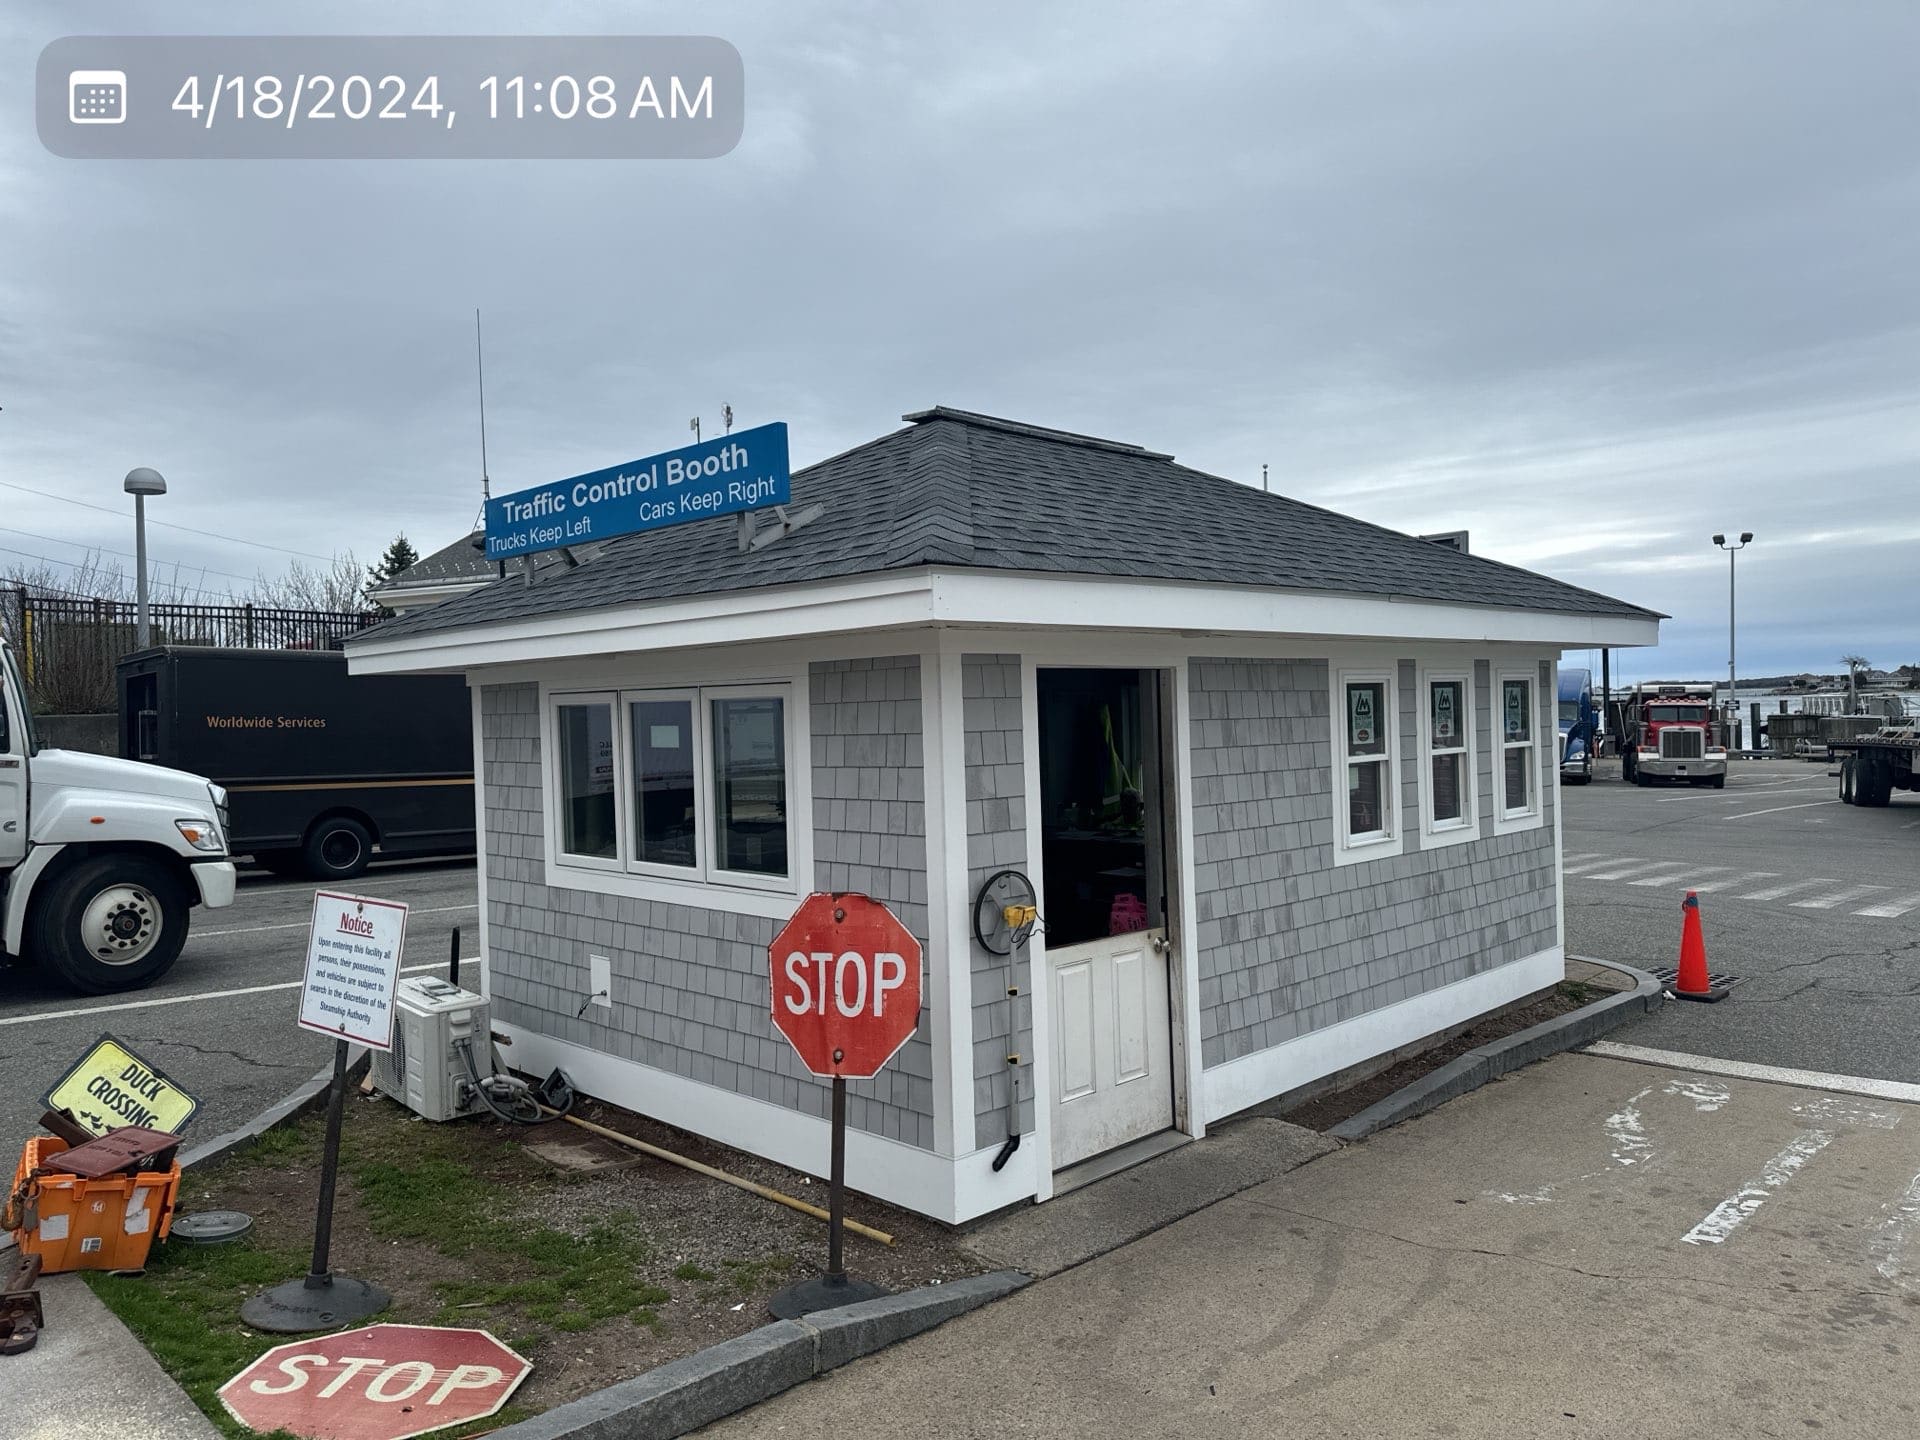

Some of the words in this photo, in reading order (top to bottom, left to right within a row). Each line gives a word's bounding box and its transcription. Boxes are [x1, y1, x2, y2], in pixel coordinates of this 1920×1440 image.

[503, 491, 566, 524] Traffic
[572, 463, 658, 508] Control
[666, 442, 749, 487] Booth
[639, 500, 676, 522] Cars
[680, 489, 722, 514] Keep
[728, 475, 775, 504] Right
[489, 529, 527, 553] Trucks
[529, 523, 563, 546] Keep
[566, 515, 592, 537] Left
[206, 716, 274, 729] Worldwide
[277, 716, 326, 728] Services
[340, 912, 374, 935] Notice
[318, 937, 332, 948] Upon
[332, 941, 353, 954] entering
[354, 943, 364, 954] this
[365, 946, 383, 960] facility
[383, 950, 392, 959] all
[316, 969, 326, 978] and
[327, 971, 347, 983] vehicles
[347, 977, 357, 986] are
[357, 978, 377, 991] subject
[378, 983, 385, 992] to
[318, 954, 339, 966] persons,
[340, 957, 351, 968] their
[352, 962, 386, 976] possessions,
[310, 984, 327, 994] search
[328, 986, 333, 995] in
[334, 988, 343, 999] the
[343, 991, 370, 1005] discretion
[370, 998, 377, 1007] of
[377, 999, 387, 1010] the
[784, 951, 907, 1018] STOP
[319, 1000, 346, 1018] Steamship
[347, 1008, 372, 1025] Authority
[120, 1063, 168, 1102] DUCK
[87, 1075, 159, 1131] CROSSING
[250, 1354, 503, 1405] STOP
